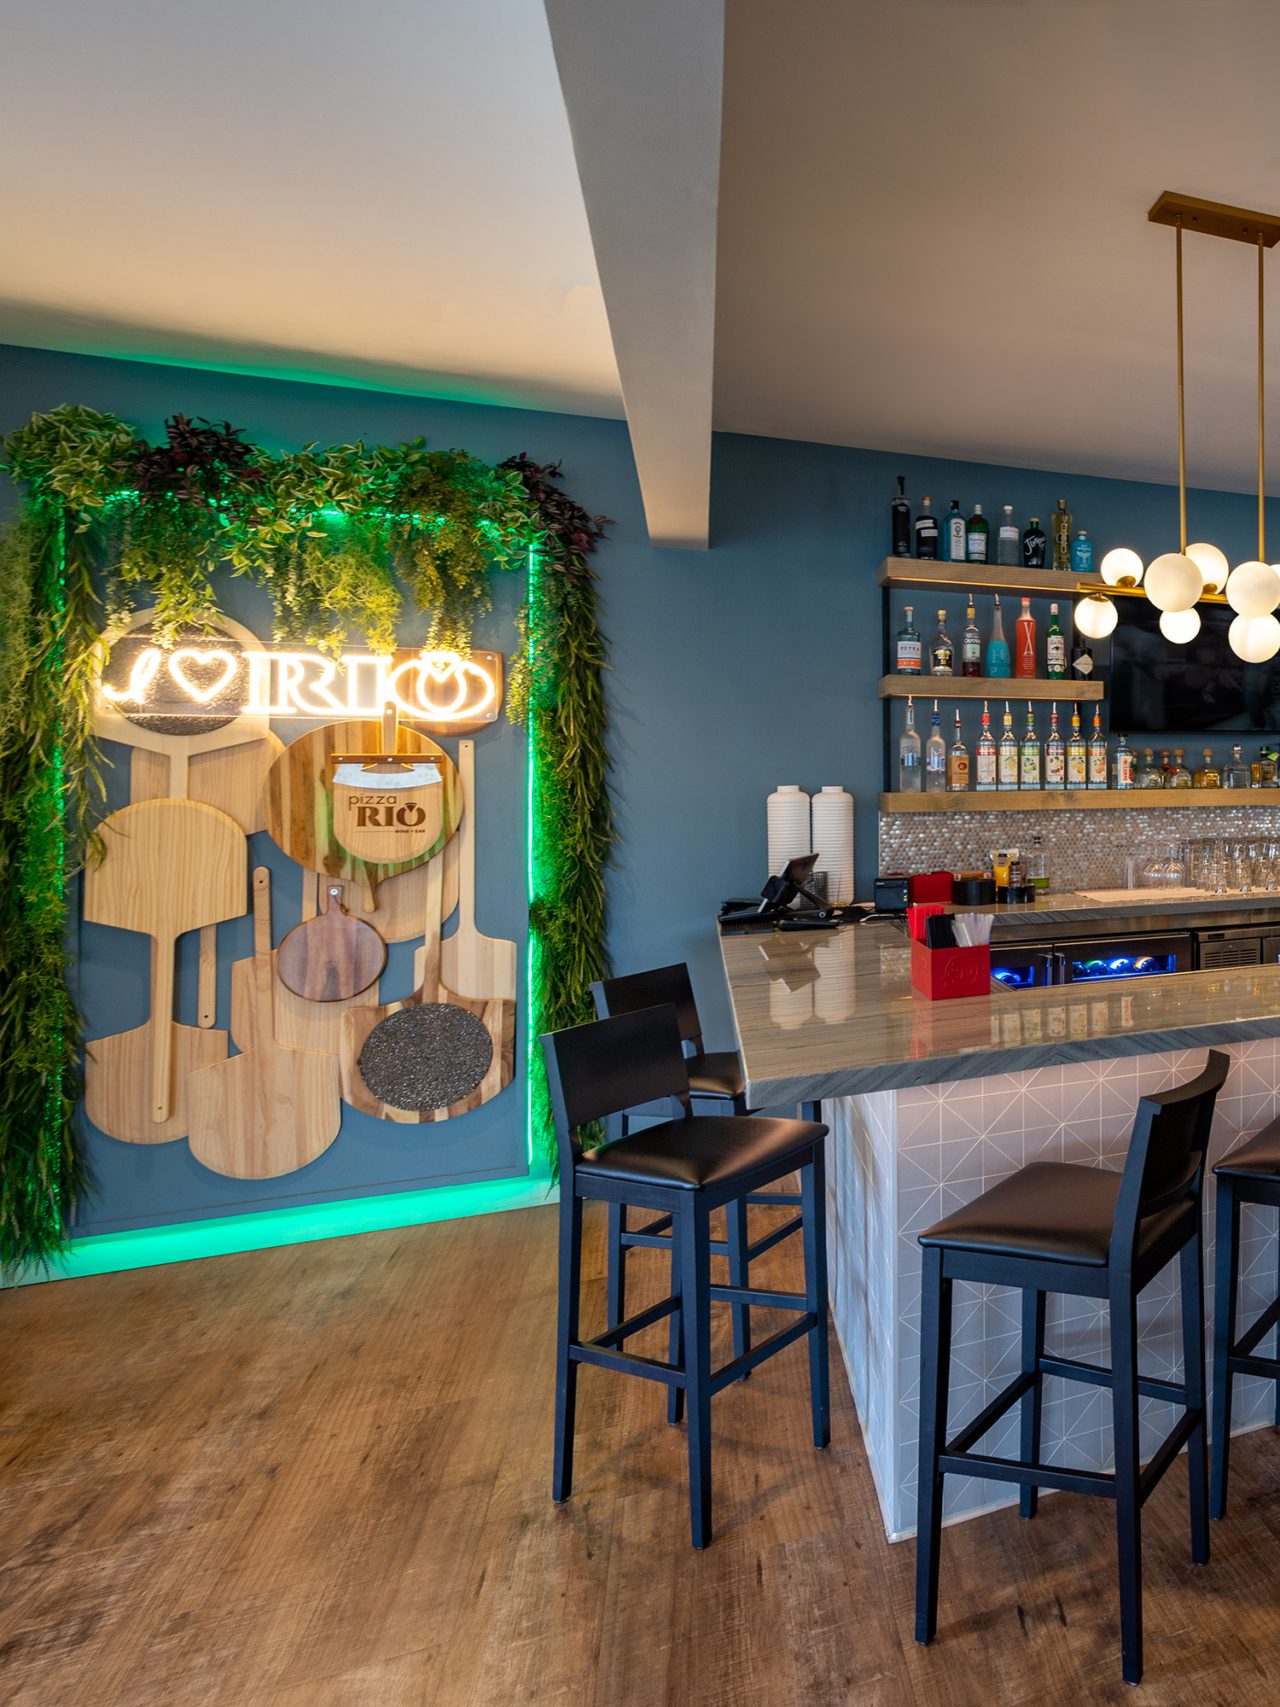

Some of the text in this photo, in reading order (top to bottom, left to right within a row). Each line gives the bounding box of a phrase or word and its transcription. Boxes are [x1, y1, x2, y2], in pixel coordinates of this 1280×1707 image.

[241, 651, 495, 720] RIO
[348, 793, 397, 811] pizza
[356, 802, 427, 827] RIO
